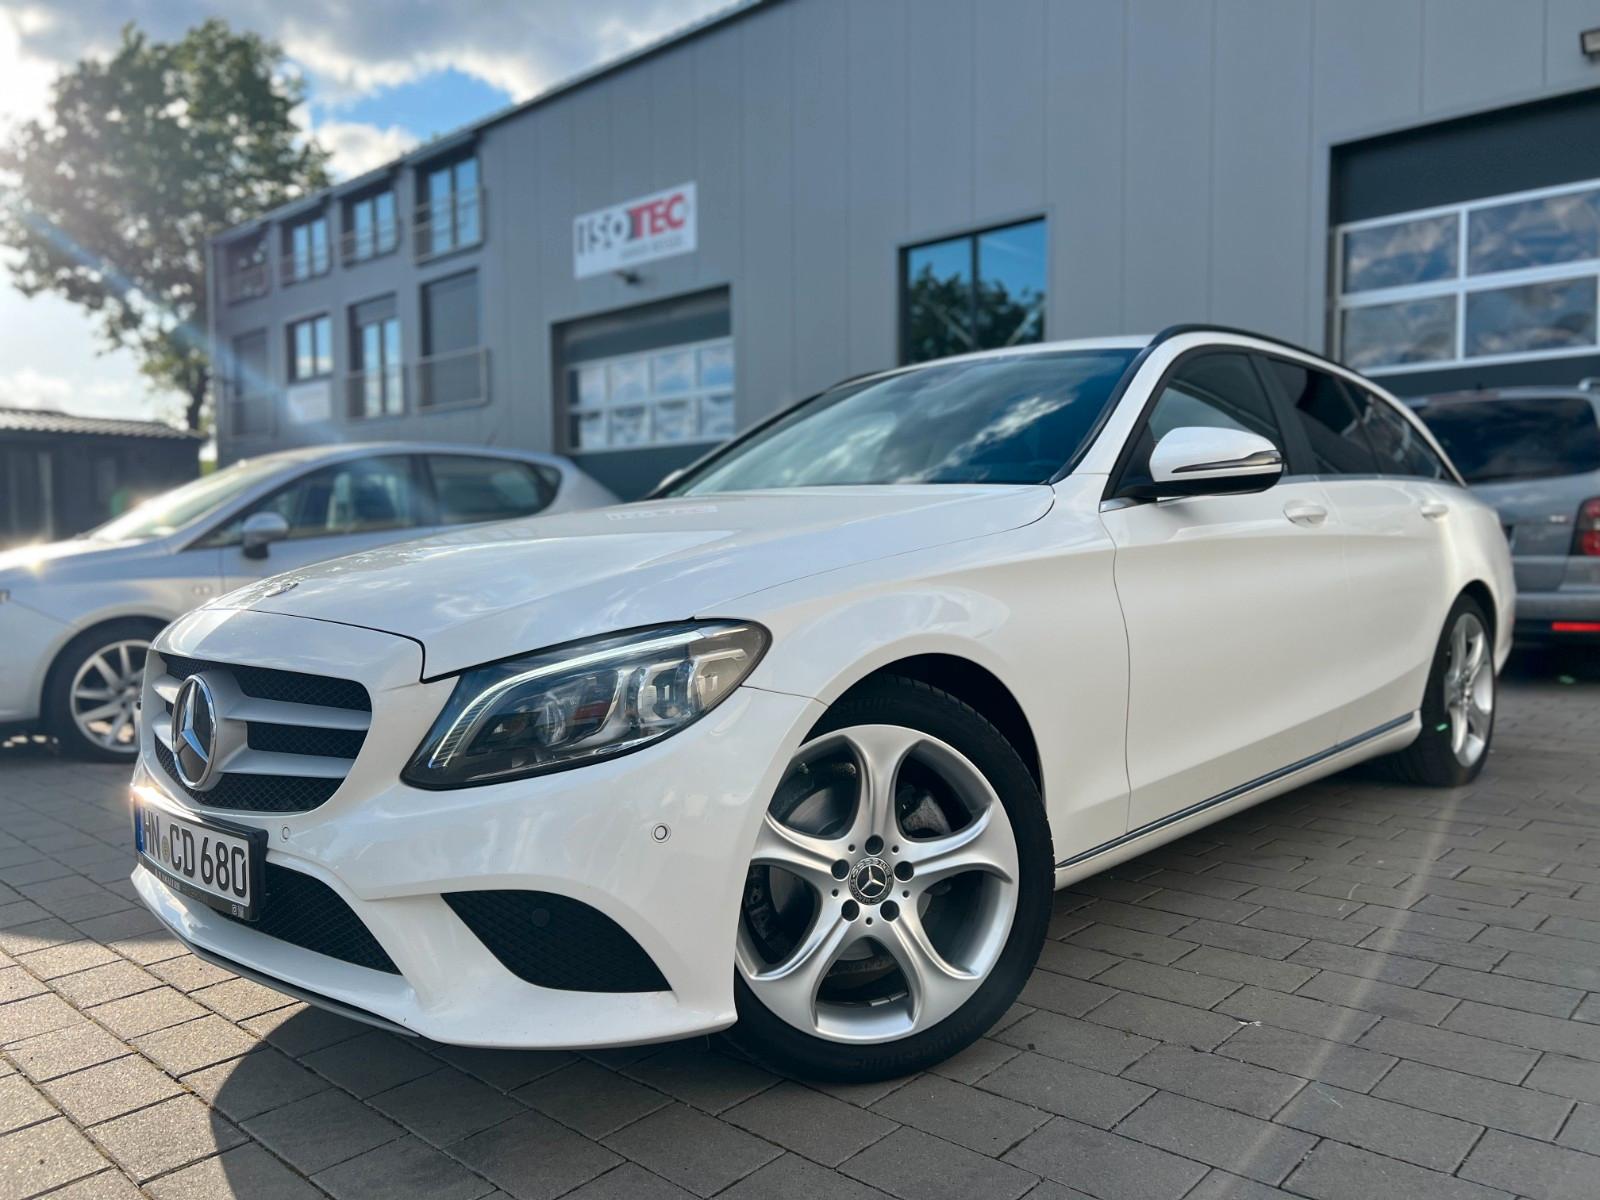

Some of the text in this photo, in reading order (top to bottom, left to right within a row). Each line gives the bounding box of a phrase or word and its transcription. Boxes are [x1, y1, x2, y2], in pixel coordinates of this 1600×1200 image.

[577, 192, 687, 255] ISOTEC
[170, 823, 195, 879] CD
[201, 836, 247, 898] 680
